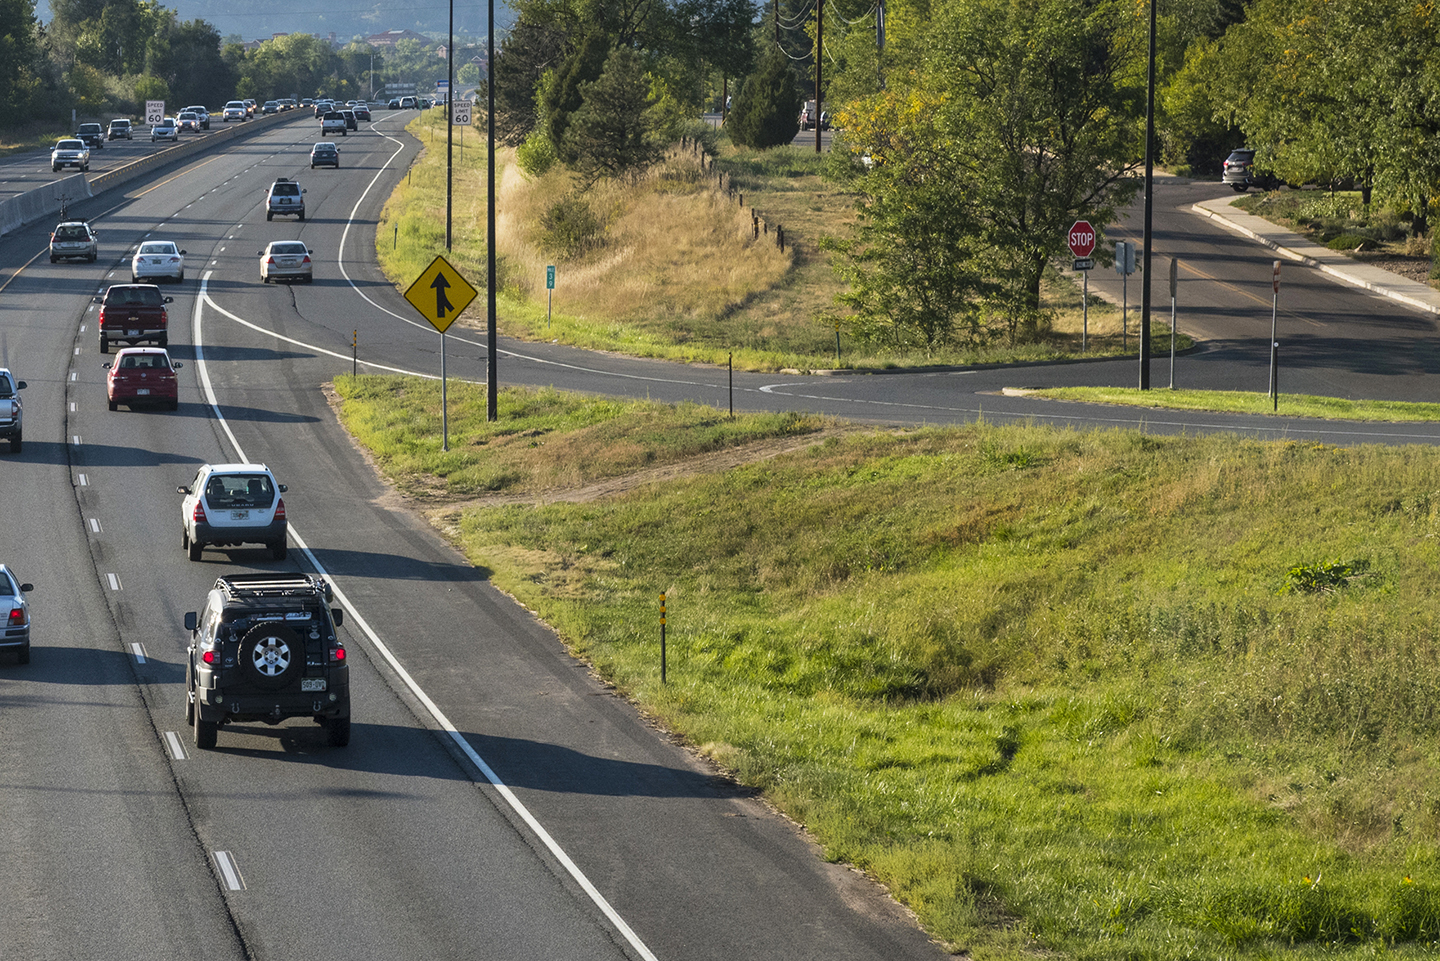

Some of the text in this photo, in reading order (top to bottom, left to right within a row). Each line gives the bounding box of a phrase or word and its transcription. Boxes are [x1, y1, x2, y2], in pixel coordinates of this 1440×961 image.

[148, 114, 161, 123] 60
[455, 114, 468, 123] 60
[1071, 232, 1093, 246] STOP
